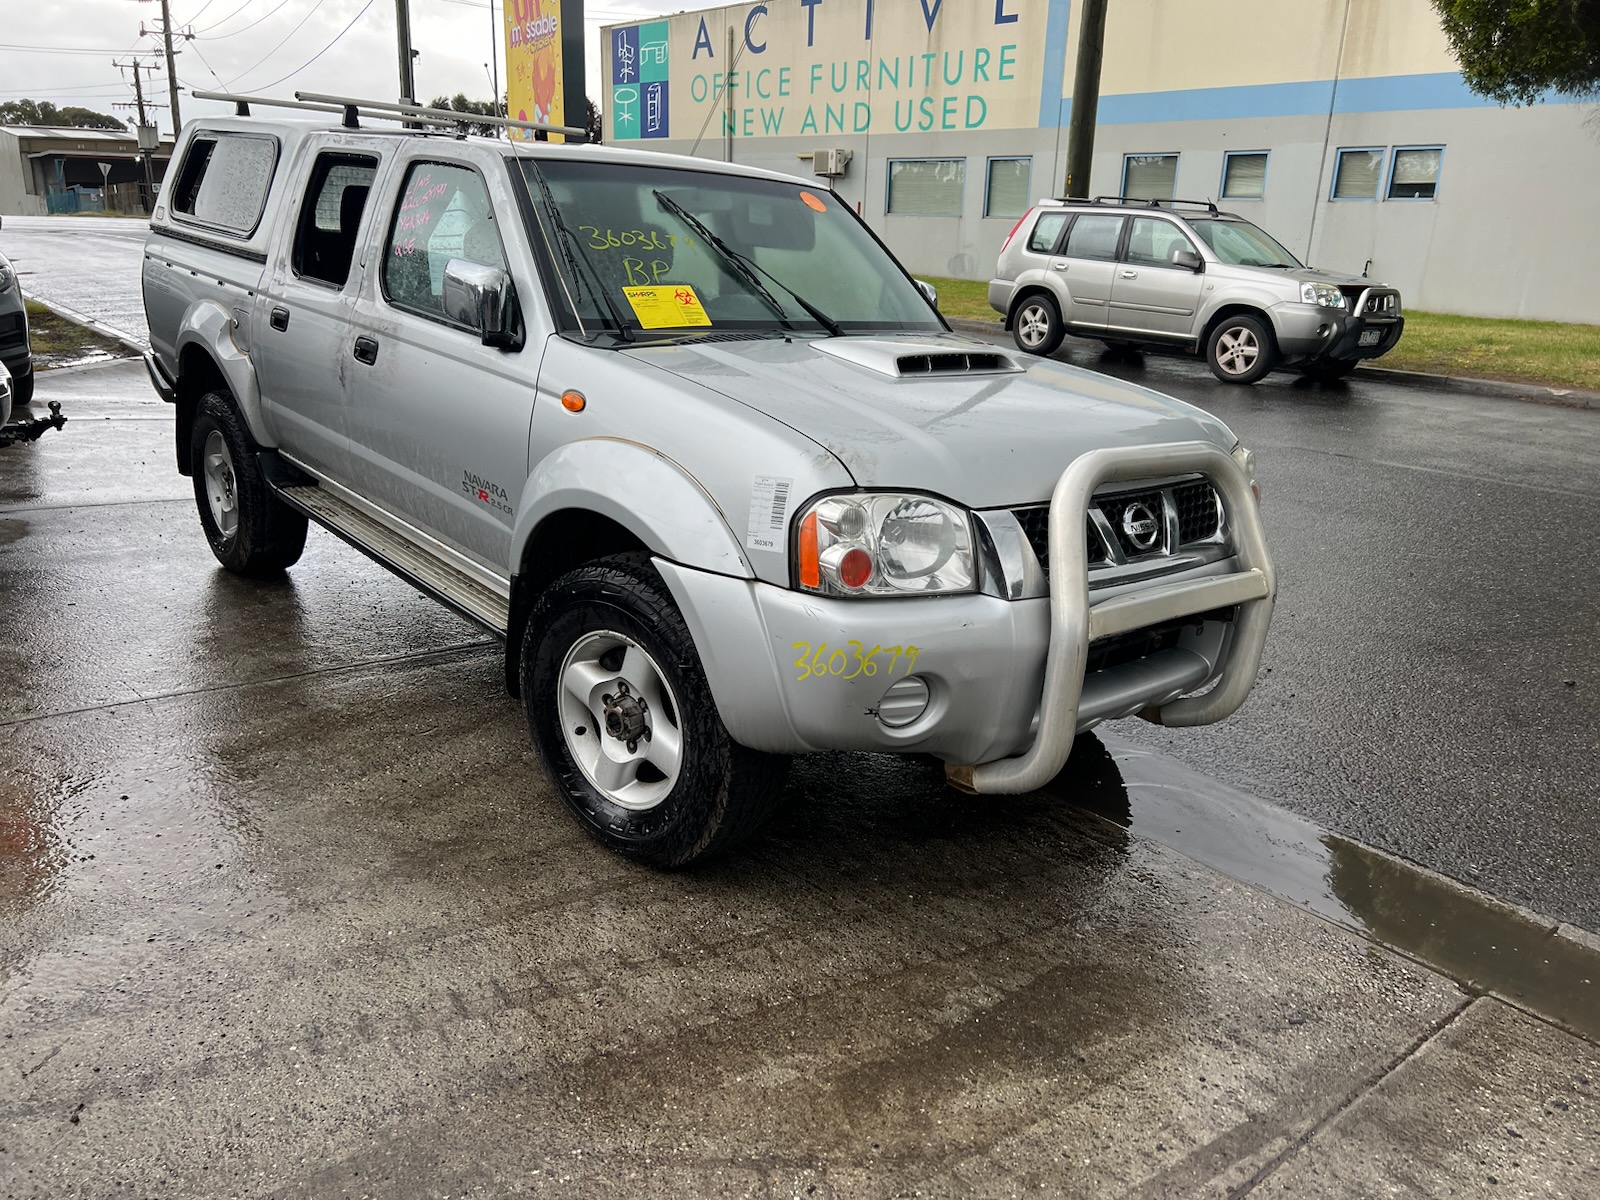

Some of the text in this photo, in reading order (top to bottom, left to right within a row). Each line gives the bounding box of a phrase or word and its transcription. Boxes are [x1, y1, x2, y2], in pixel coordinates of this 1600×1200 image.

[691, 44, 1017, 103] OFFICE FURNITURE
[722, 95, 987, 137] NEW AND USED
[622, 257, 669, 287] BP
[463, 470, 508, 502] NAVARA
[792, 640, 920, 681] 3603679
